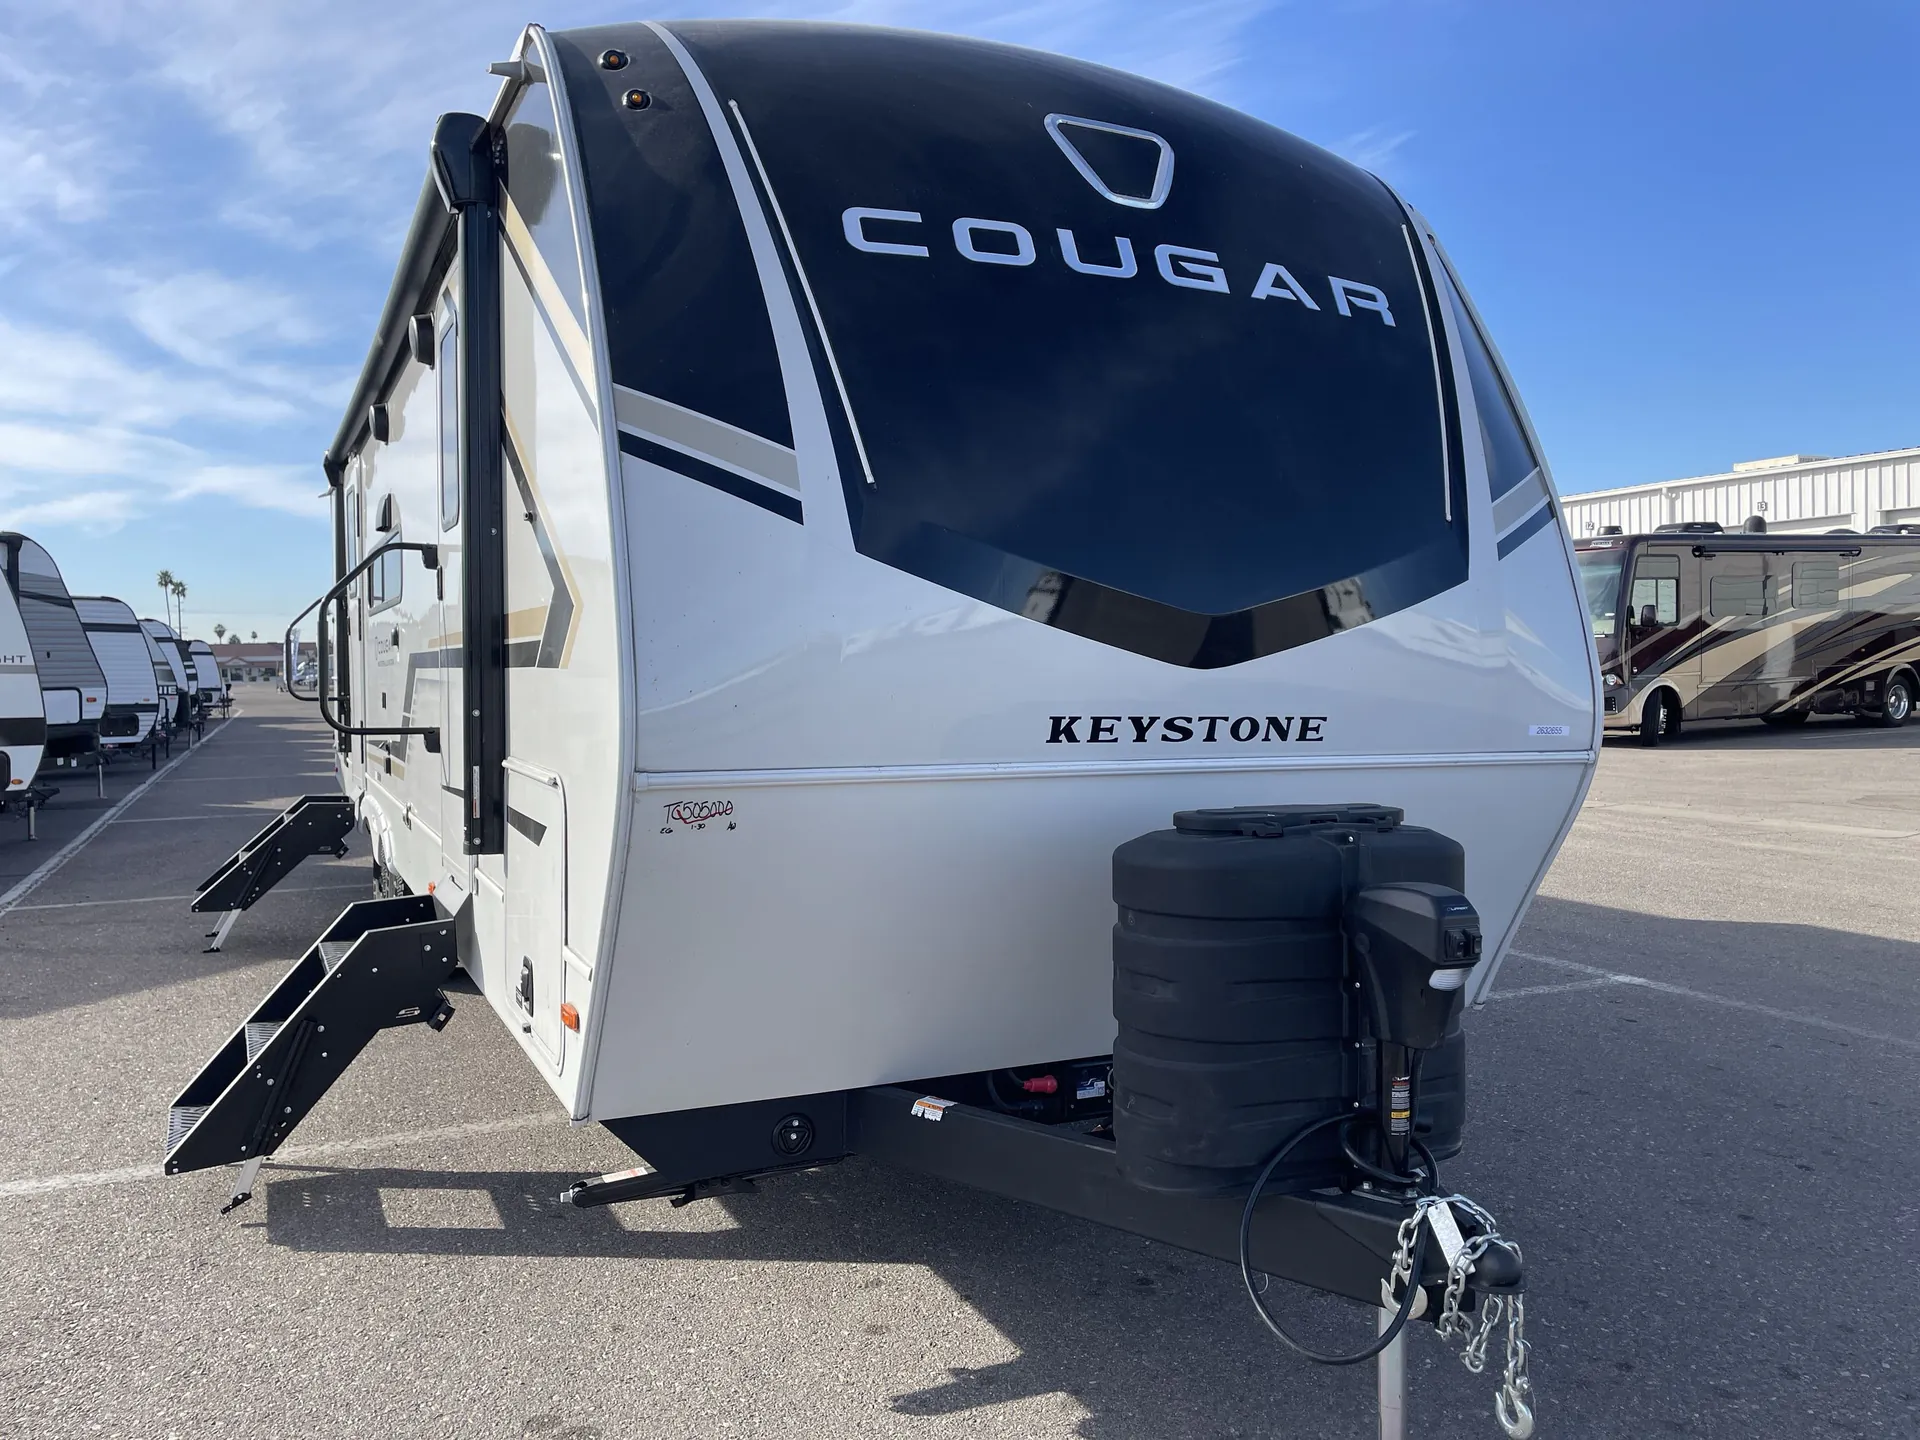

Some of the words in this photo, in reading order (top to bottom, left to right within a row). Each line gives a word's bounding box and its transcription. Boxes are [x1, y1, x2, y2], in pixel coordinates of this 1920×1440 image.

[841, 206, 1397, 328] COUGAR
[1757, 502, 1766, 511] 13
[0, 655, 26, 663] HT
[1045, 715, 1328, 744] KEYSTONE
